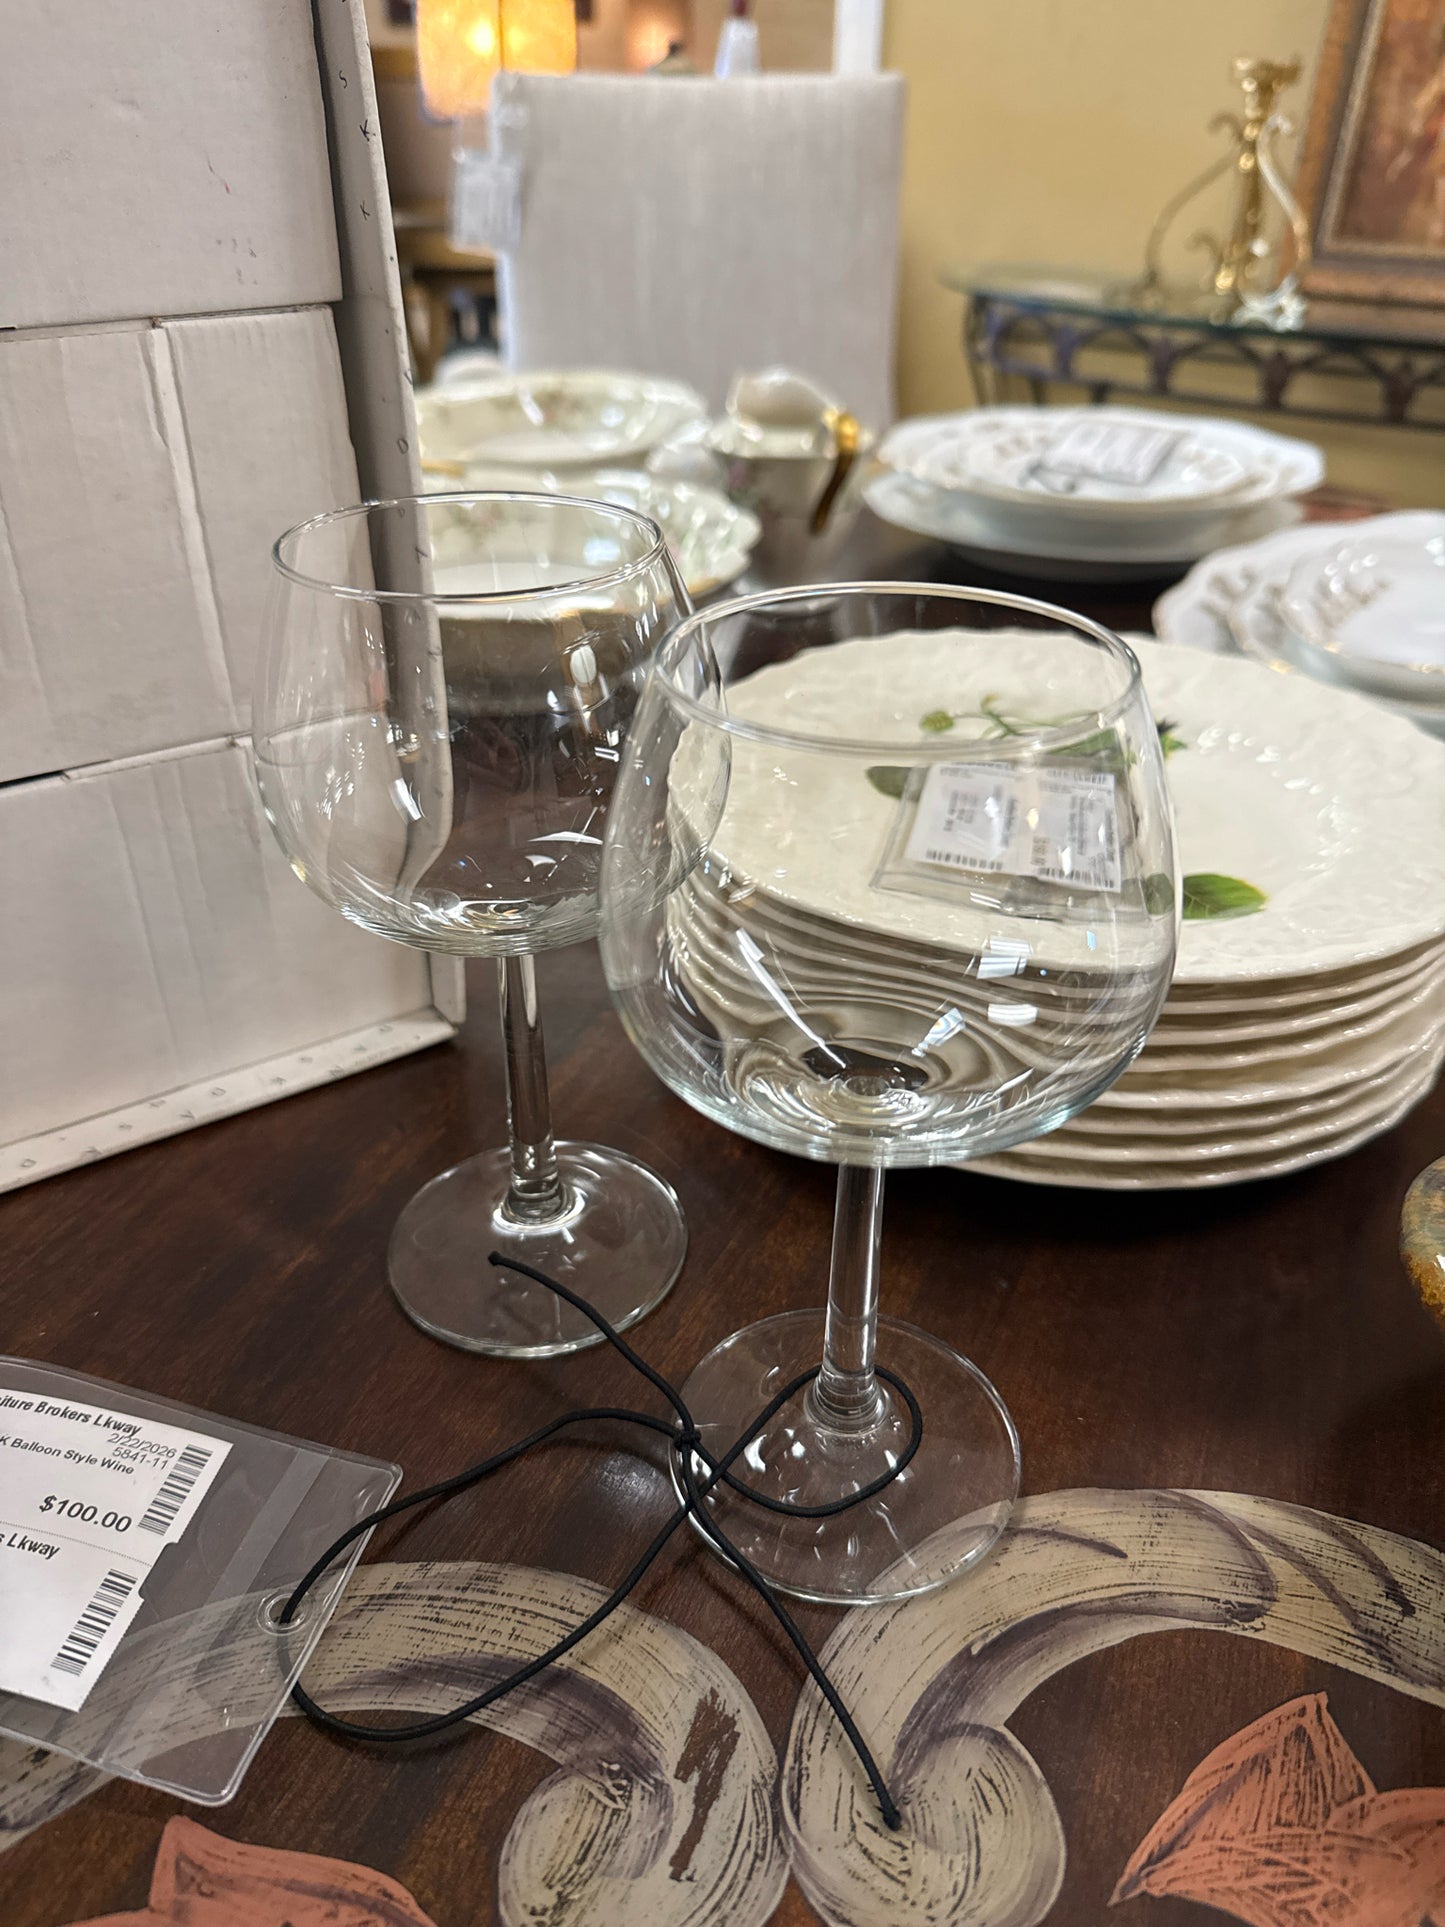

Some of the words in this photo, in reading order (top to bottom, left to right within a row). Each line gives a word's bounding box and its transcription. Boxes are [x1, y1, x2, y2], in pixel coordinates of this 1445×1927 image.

[34, 1401, 92, 1423] Brokers
[93, 1414, 142, 1437] Lkway
[11, 1438, 62, 1457] Balloon
[63, 1449, 98, 1464] Style
[99, 1457, 134, 1475] Wine
[107, 1432, 177, 1459] 2/22/2026
[112, 1446, 168, 1470] 5841-11
[39, 1495, 132, 1532] $100.00
[7, 1532, 61, 1560] Lkway
